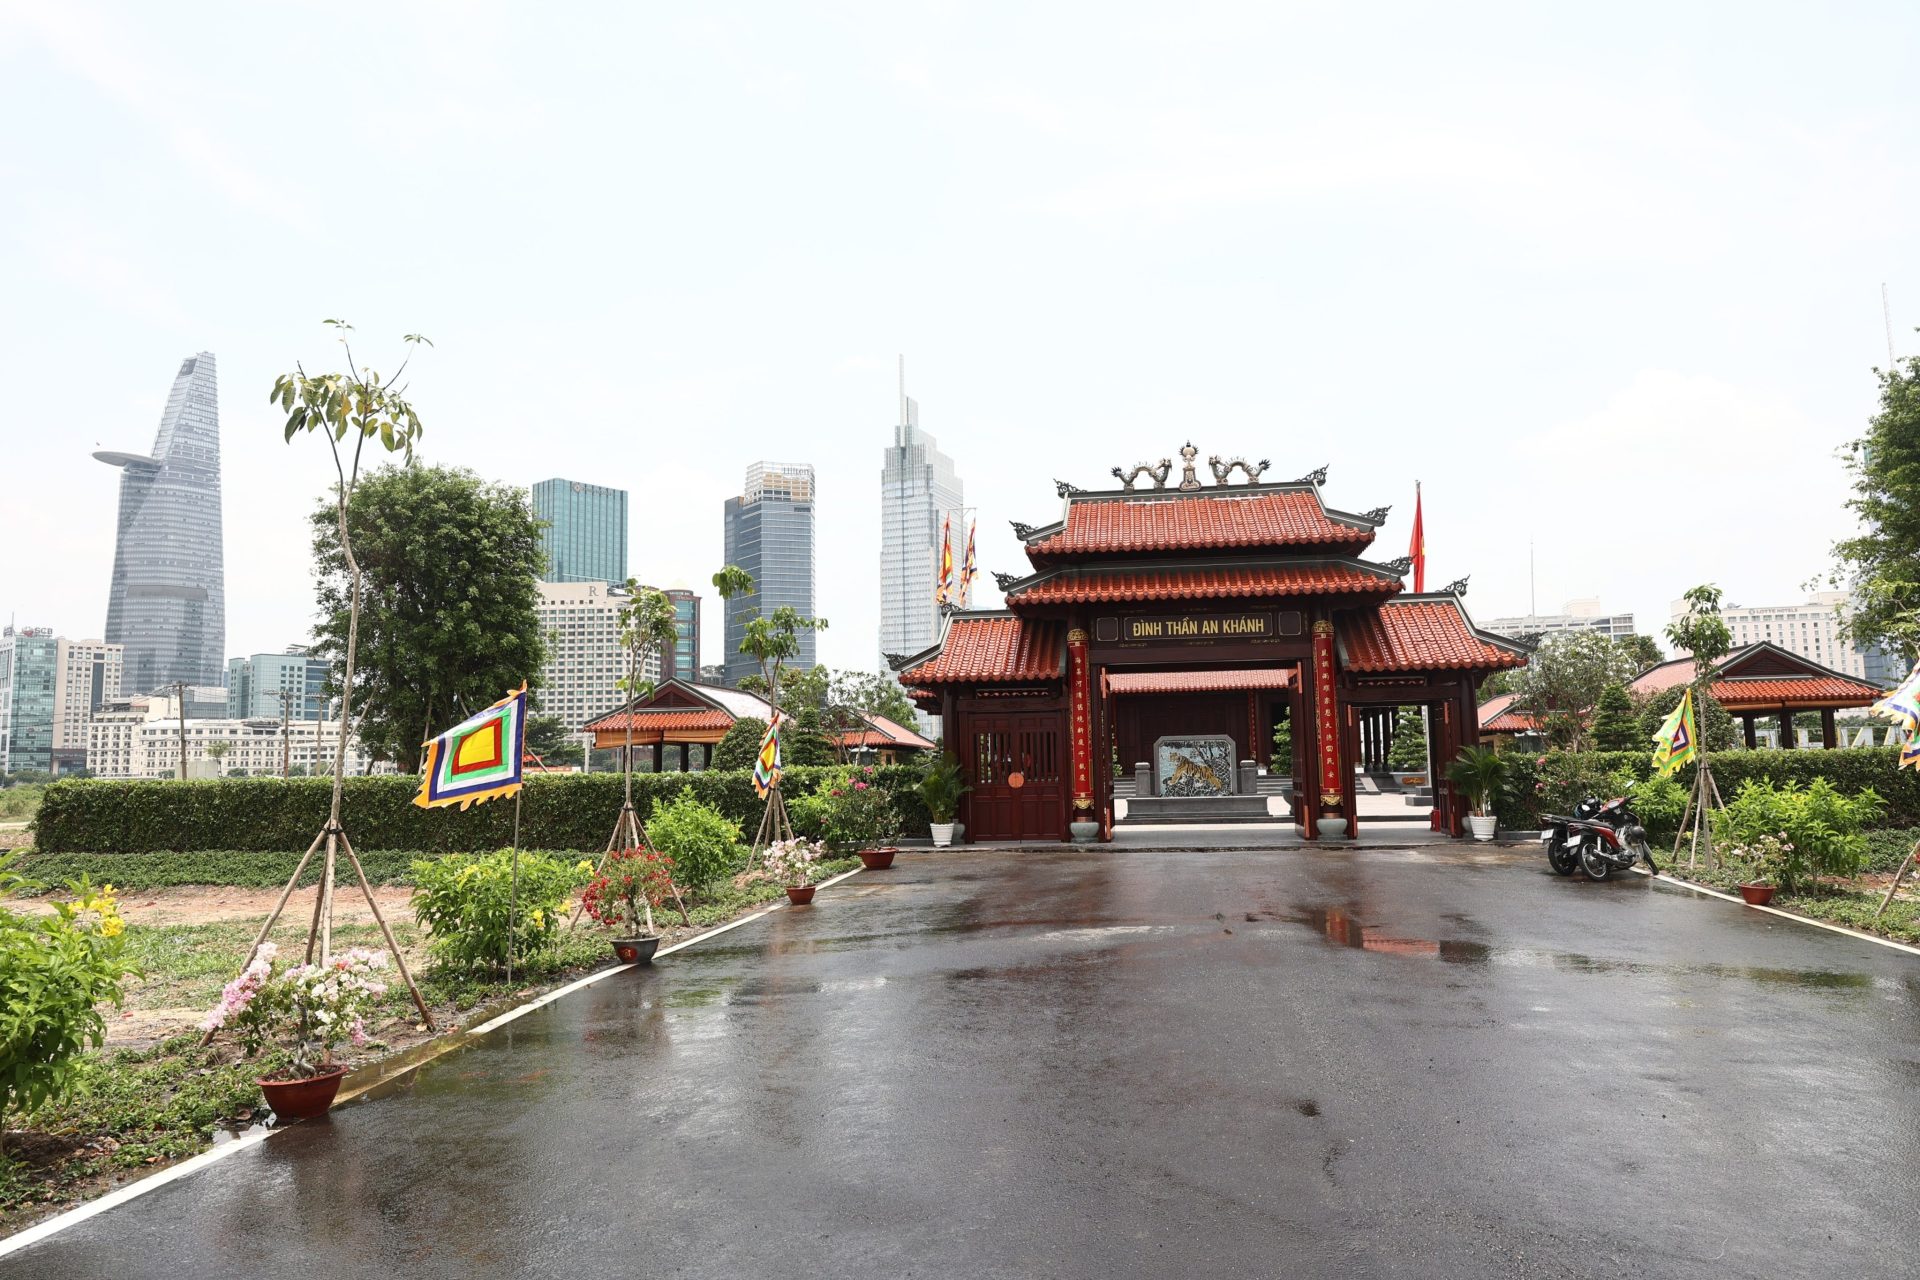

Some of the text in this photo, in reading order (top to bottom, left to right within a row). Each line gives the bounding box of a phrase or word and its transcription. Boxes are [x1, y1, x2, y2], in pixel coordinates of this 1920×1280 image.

[783, 466, 810, 476] Hilton
[588, 585, 599, 597] R
[1132, 616, 1264, 637] ĐÌNH THẦN AN KHÁNH
